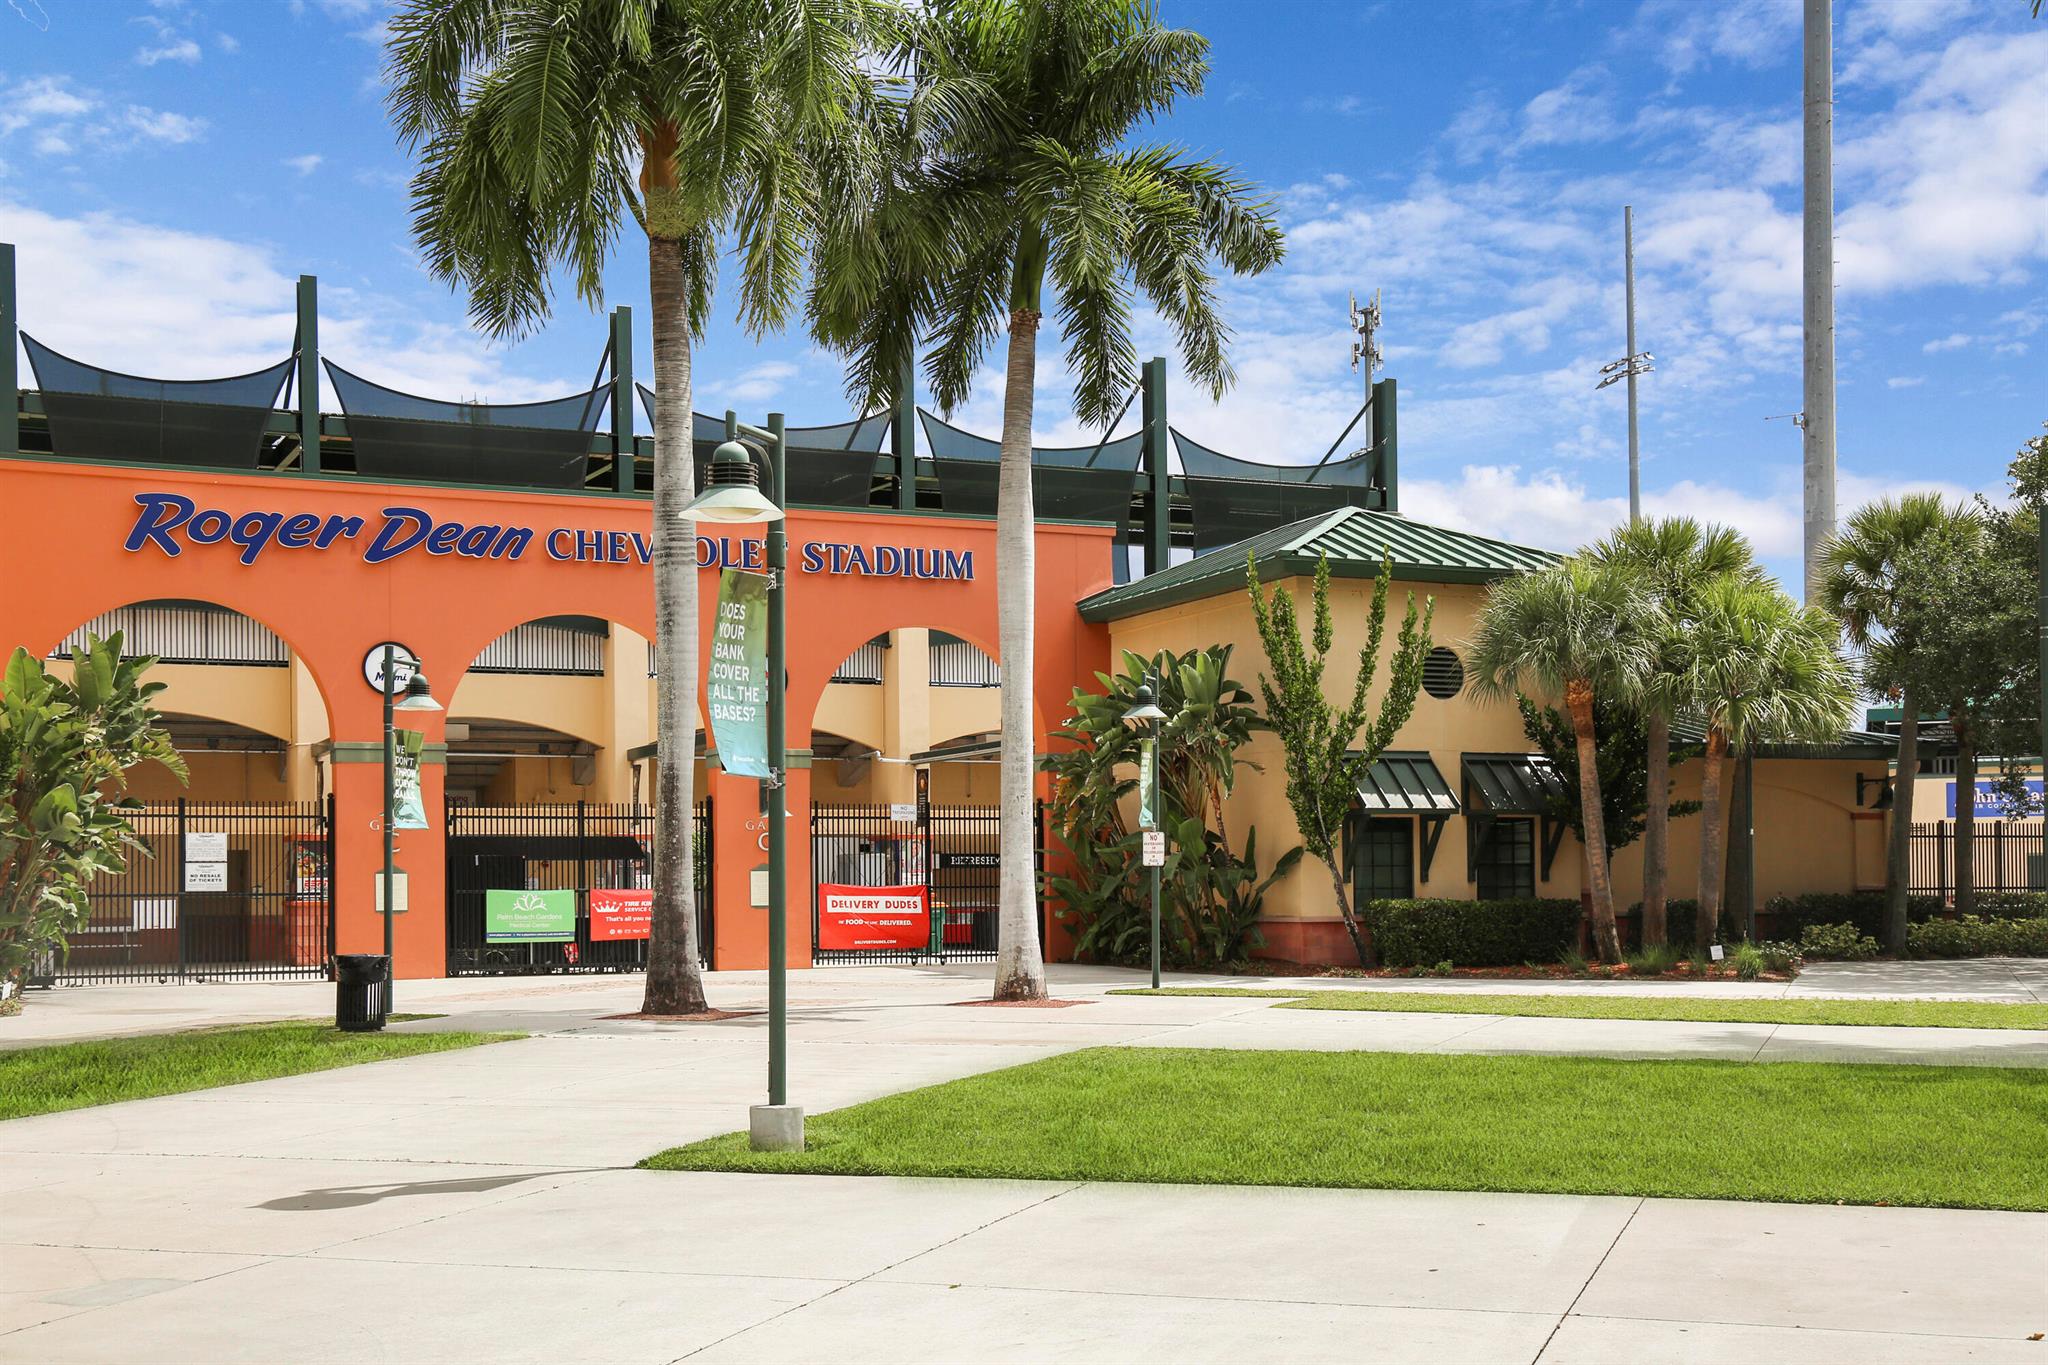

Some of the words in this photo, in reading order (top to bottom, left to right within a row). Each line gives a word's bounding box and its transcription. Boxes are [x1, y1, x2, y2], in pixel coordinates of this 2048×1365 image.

[124, 492, 365, 567] Roger
[363, 506, 535, 565] Dean
[546, 526, 790, 571] CHEVOLE
[802, 541, 976, 582] STADIUM
[721, 601, 746, 621] DOES
[719, 622, 745, 641] YOUR
[715, 643, 745, 661] BANK
[374, 671, 408, 682] Mmi
[713, 662, 750, 682] COVER
[713, 683, 735, 701] ALL
[738, 686, 760, 703] THE
[713, 703, 756, 723] BASES?
[396, 744, 406, 754] WE
[395, 756, 415, 767] DON'T
[395, 766, 417, 778] THROW
[395, 778, 417, 789] CURVE
[831, 900, 880, 909] DELIVERY
[885, 900, 918, 909] DUDES
